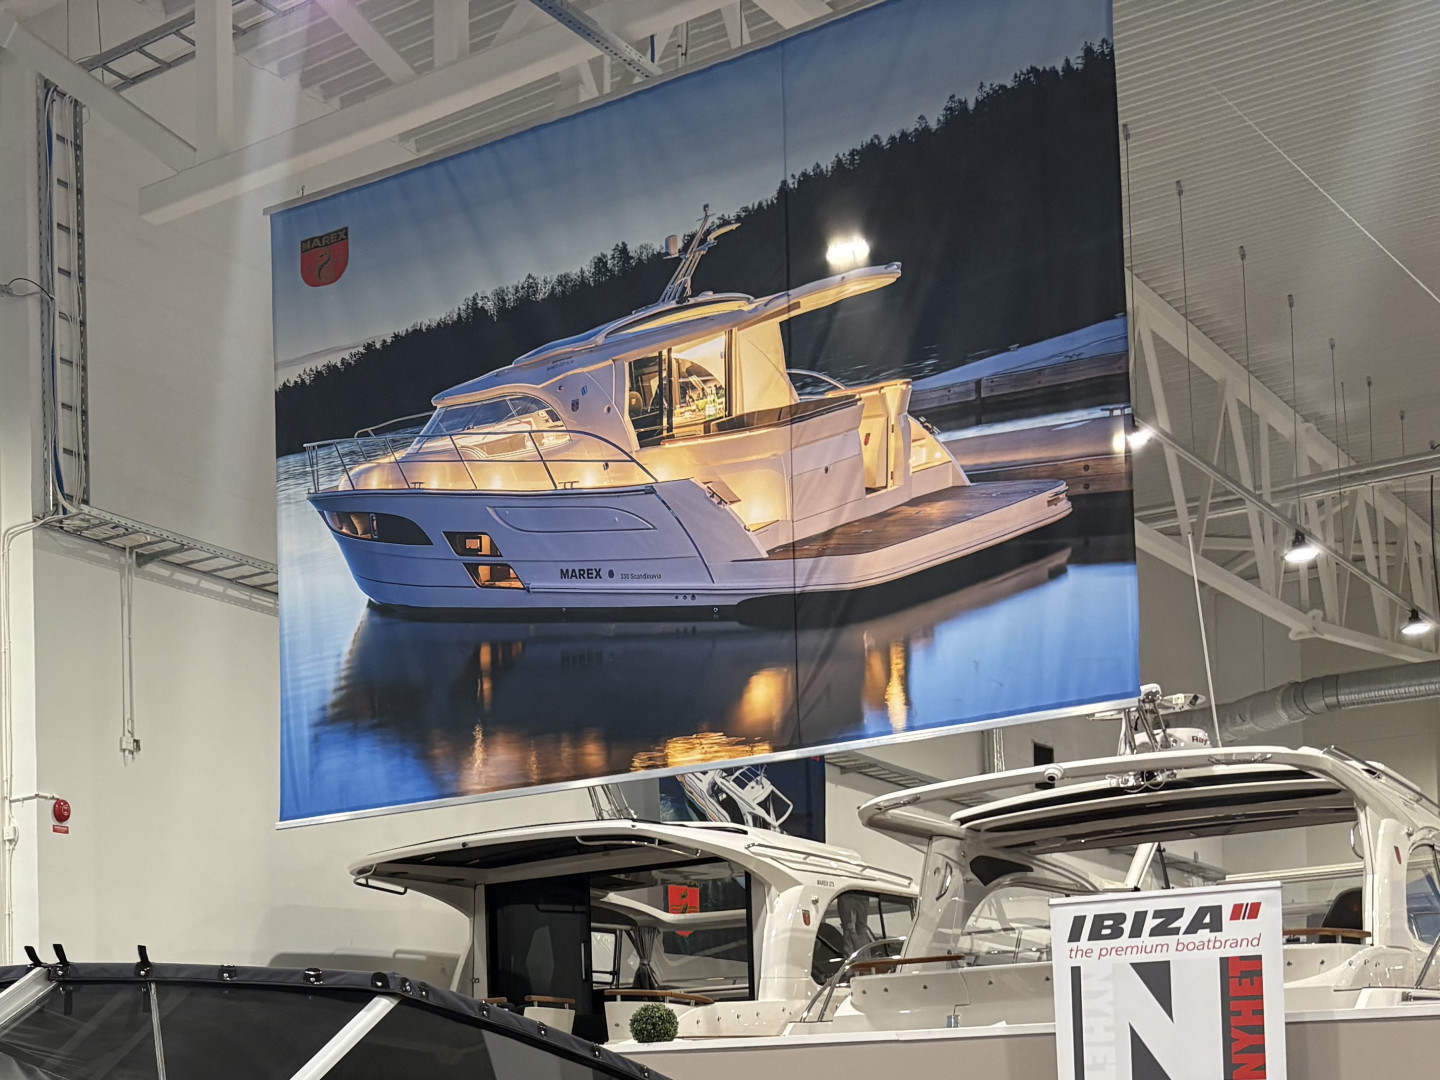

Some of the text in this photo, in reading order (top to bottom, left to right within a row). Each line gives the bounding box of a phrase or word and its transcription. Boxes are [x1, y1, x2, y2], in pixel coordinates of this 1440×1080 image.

[302, 229, 347, 251] MAREX
[560, 568, 602, 580] MAREX
[1067, 905, 1223, 943] IBIZA
[1069, 933, 1262, 960] the premium boatbrand
[1228, 956, 1267, 1080] NYHET
